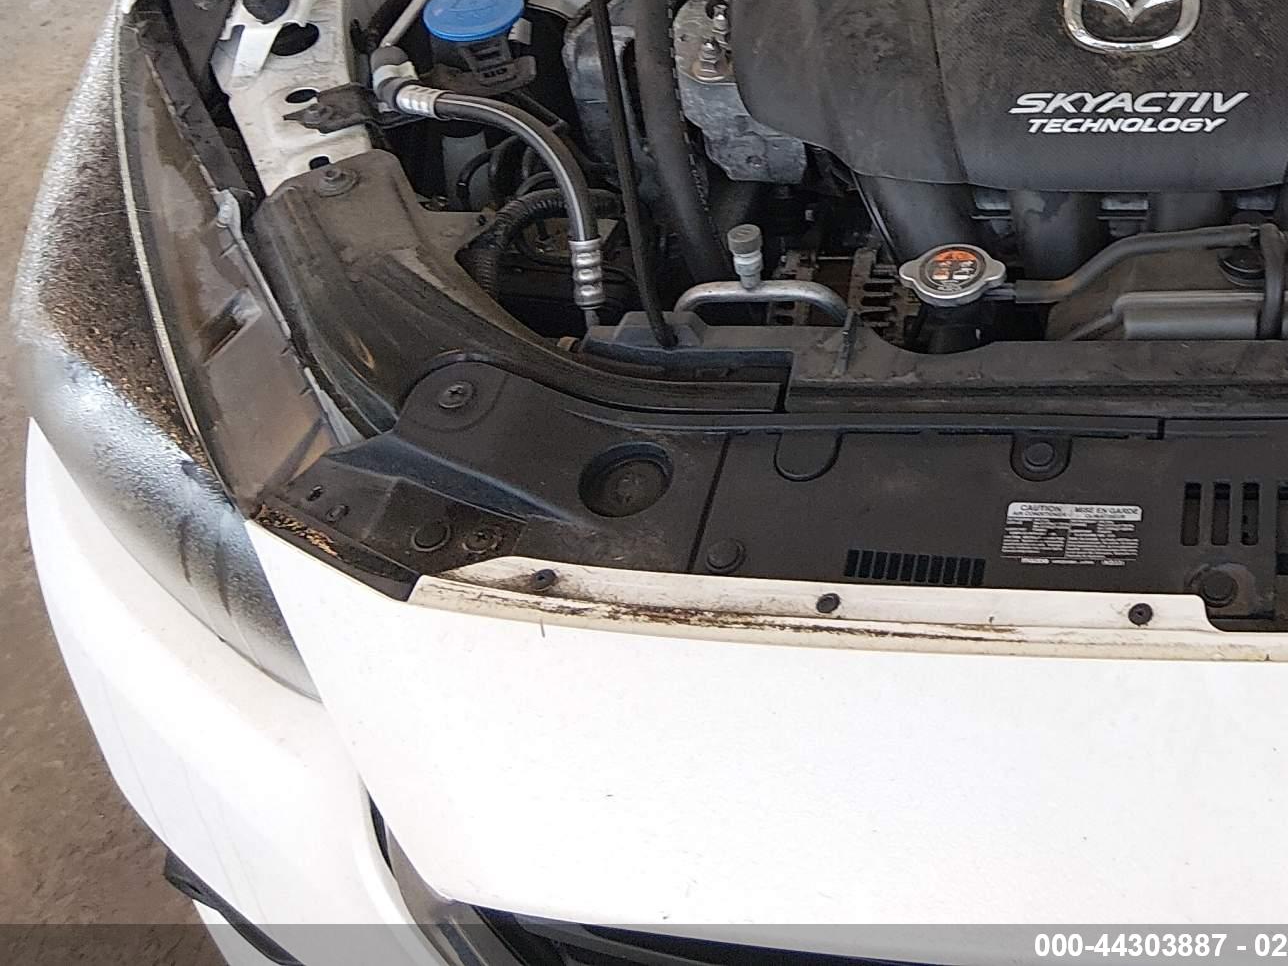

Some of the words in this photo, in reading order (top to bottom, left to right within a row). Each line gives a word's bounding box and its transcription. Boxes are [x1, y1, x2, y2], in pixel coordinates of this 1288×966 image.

[1008, 92, 1250, 113] SKYACTIV
[1028, 118, 1227, 133] TECHNOLOGY
[1019, 504, 1062, 512] CAUTION
